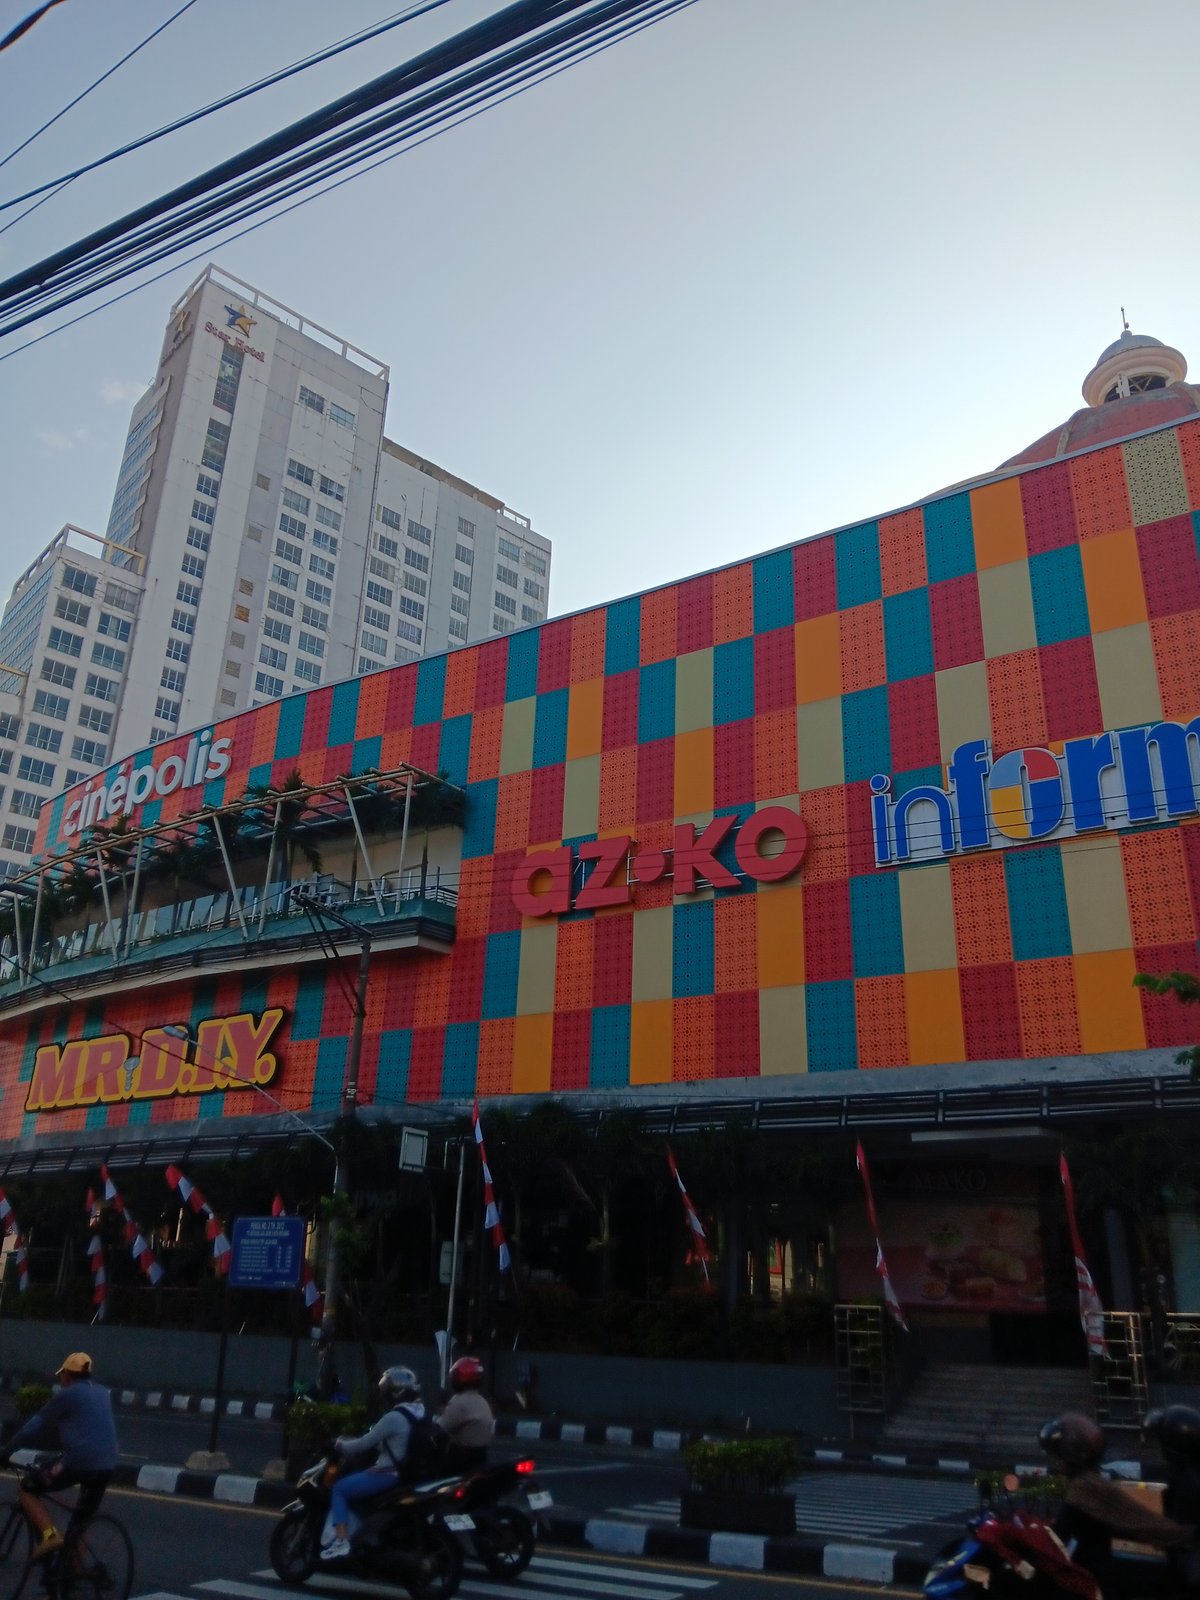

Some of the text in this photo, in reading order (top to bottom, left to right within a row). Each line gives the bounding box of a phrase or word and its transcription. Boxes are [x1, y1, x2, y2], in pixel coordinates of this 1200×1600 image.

[205, 321, 265, 363] Star Hotel
[63, 729, 233, 837] cinépolis
